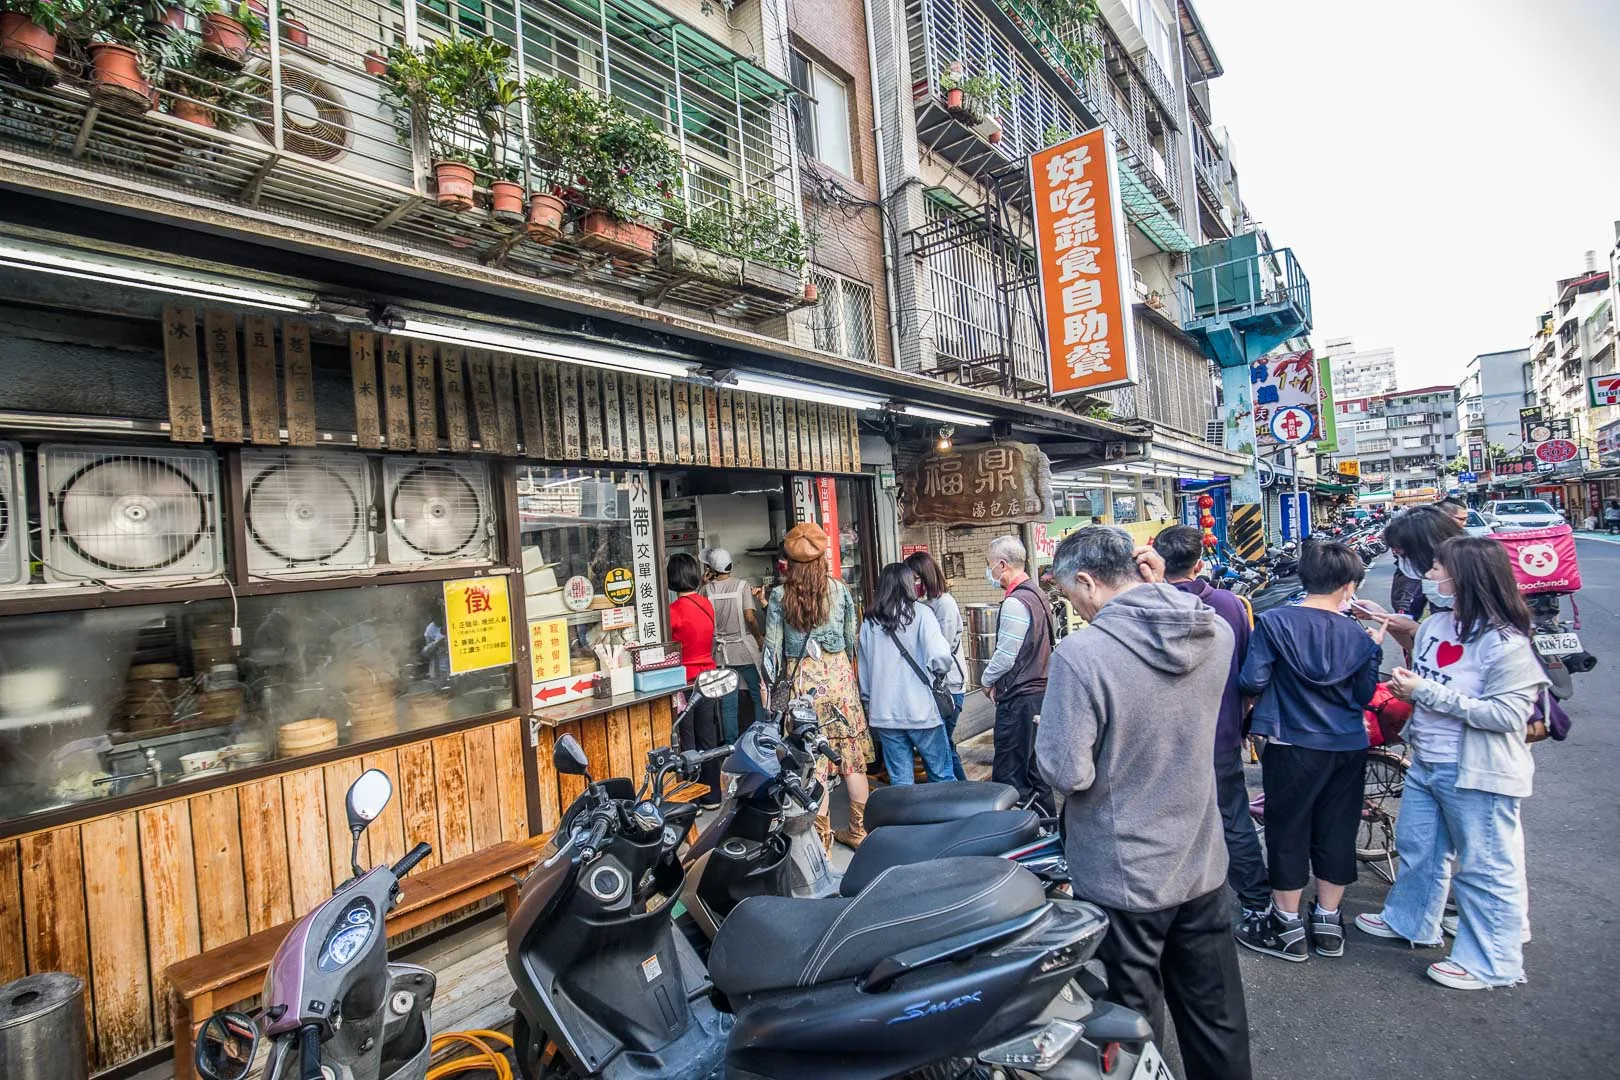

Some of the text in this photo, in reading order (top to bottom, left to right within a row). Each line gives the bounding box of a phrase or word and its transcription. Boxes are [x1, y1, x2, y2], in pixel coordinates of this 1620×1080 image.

[1045, 145, 1112, 380] 好吃蔬食自助餐
[168, 321, 197, 422] 冰紅茶
[567, 448, 579, 458] 45
[923, 448, 1018, 498] 福鼎
[972, 500, 1019, 519] 湯包店
[464, 586, 492, 614] 徵
[1516, 578, 1569, 590] foodpanda
[533, 626, 545, 677] 禁帶外食
[549, 624, 561, 674] 寵物留步
[1418, 636, 1439, 662] I
